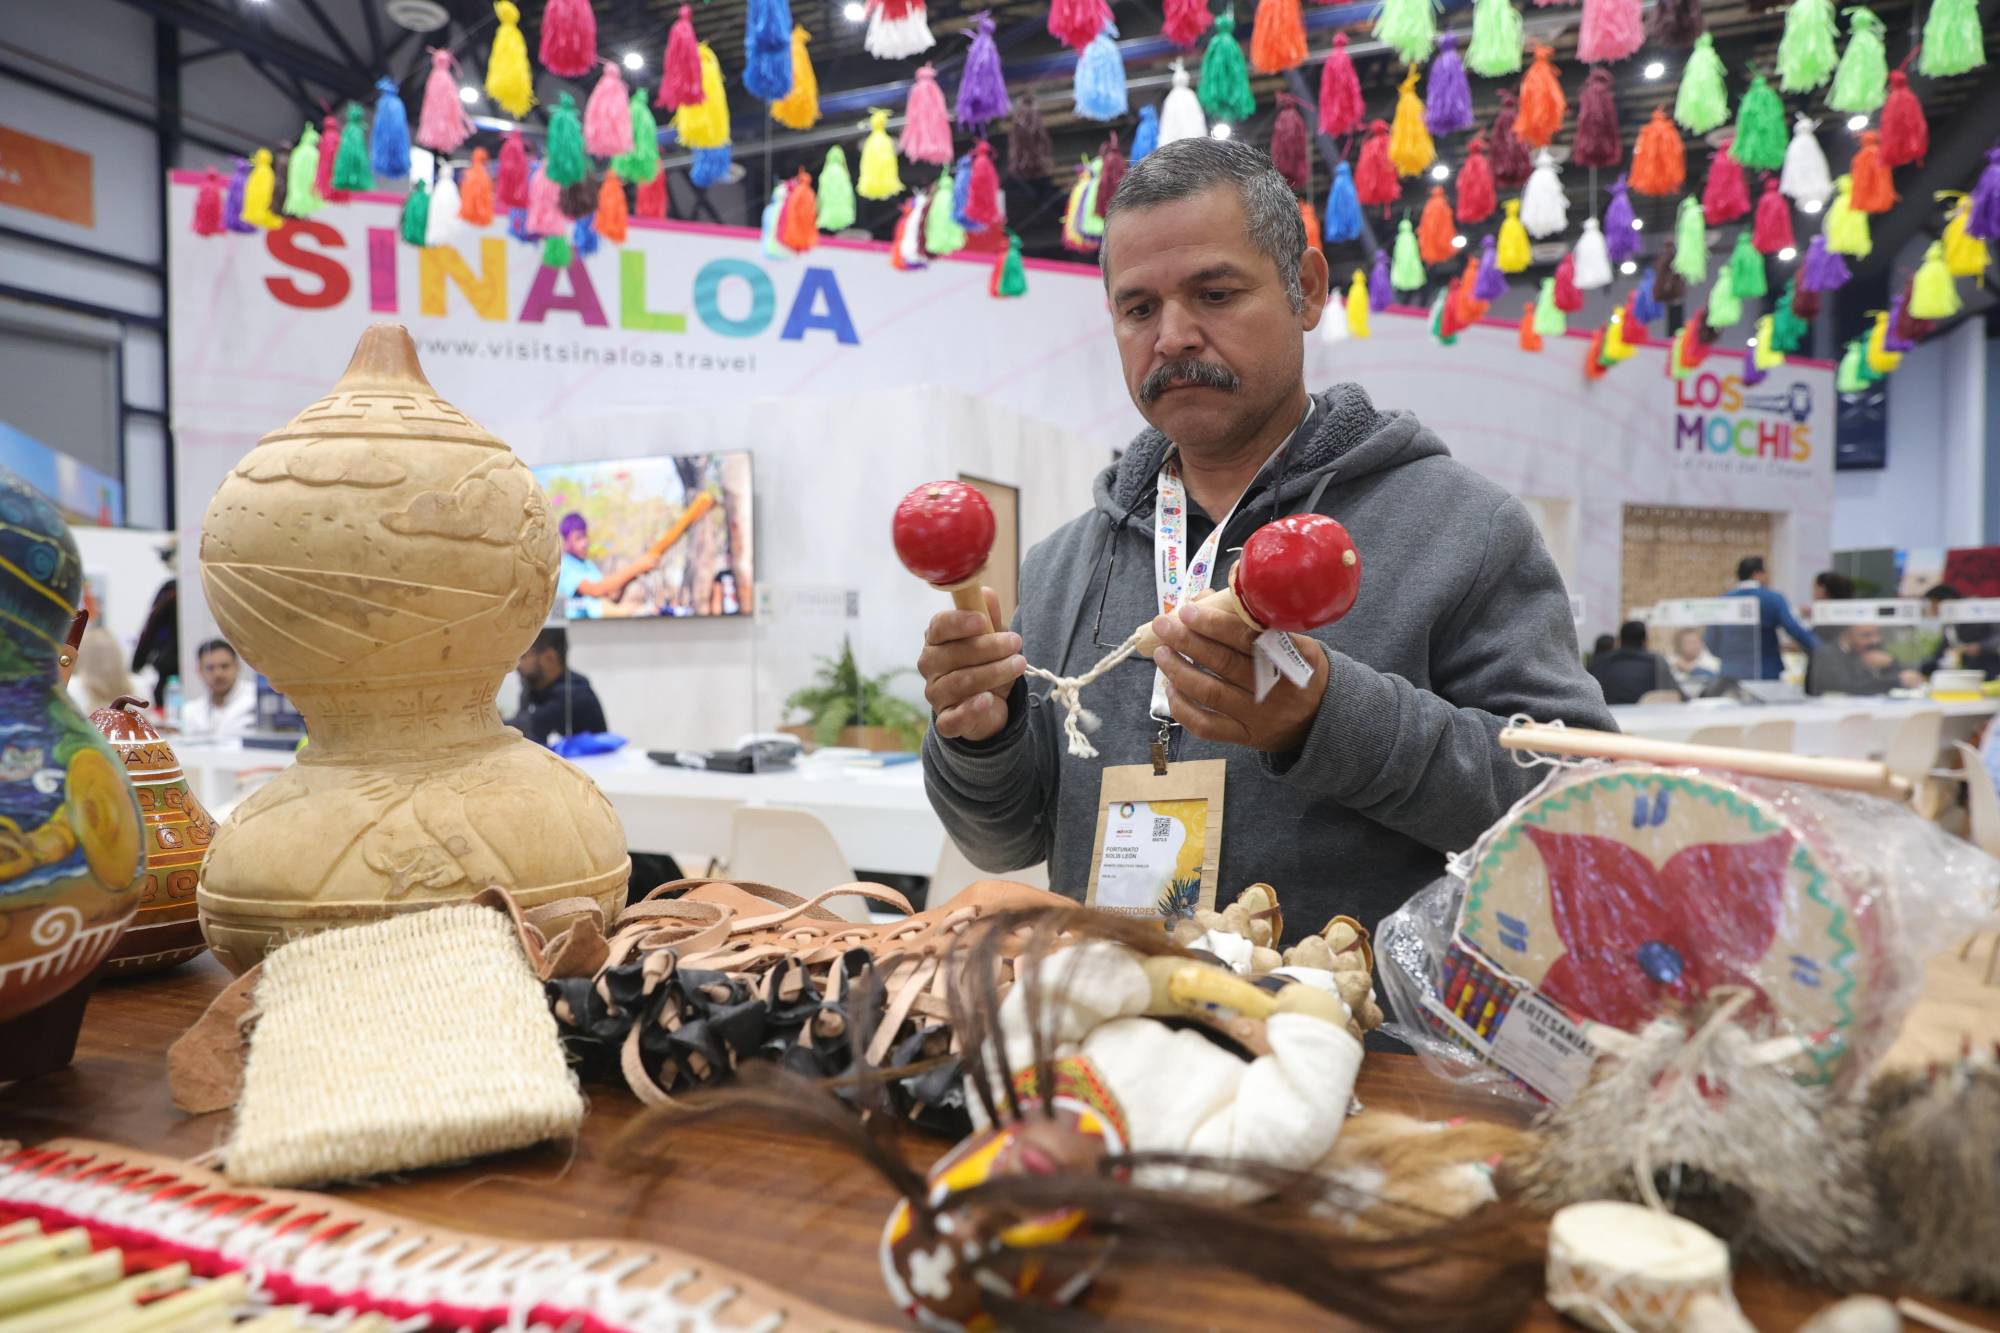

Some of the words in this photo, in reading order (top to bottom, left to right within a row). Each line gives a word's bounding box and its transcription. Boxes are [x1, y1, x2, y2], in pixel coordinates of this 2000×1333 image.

[264, 220, 862, 347] SINALOA
[1676, 372, 1744, 412] LOS
[1675, 413, 1812, 463] MOCHIS
[117, 747, 175, 765] AYAS
